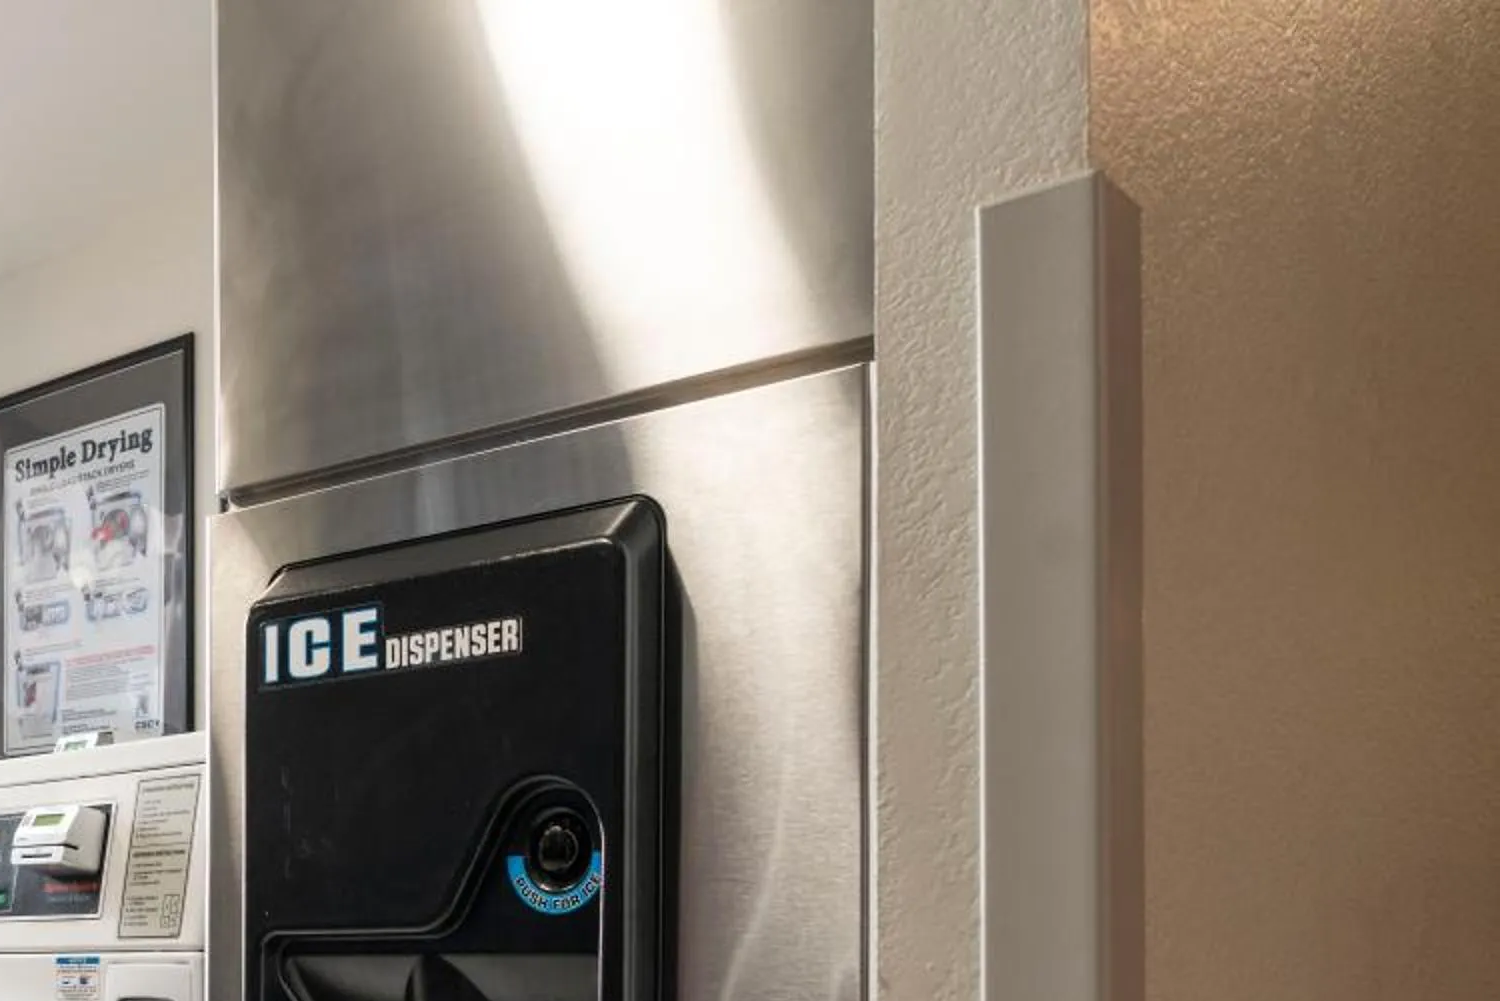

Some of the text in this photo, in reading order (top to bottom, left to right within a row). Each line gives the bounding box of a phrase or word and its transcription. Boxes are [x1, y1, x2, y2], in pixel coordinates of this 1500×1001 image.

[15, 446, 77, 482] Simple
[81, 427, 154, 462] Drying
[263, 607, 520, 684] ICE DISPENSER
[515, 875, 549, 910] PUSH
[552, 895, 580, 910] FOR
